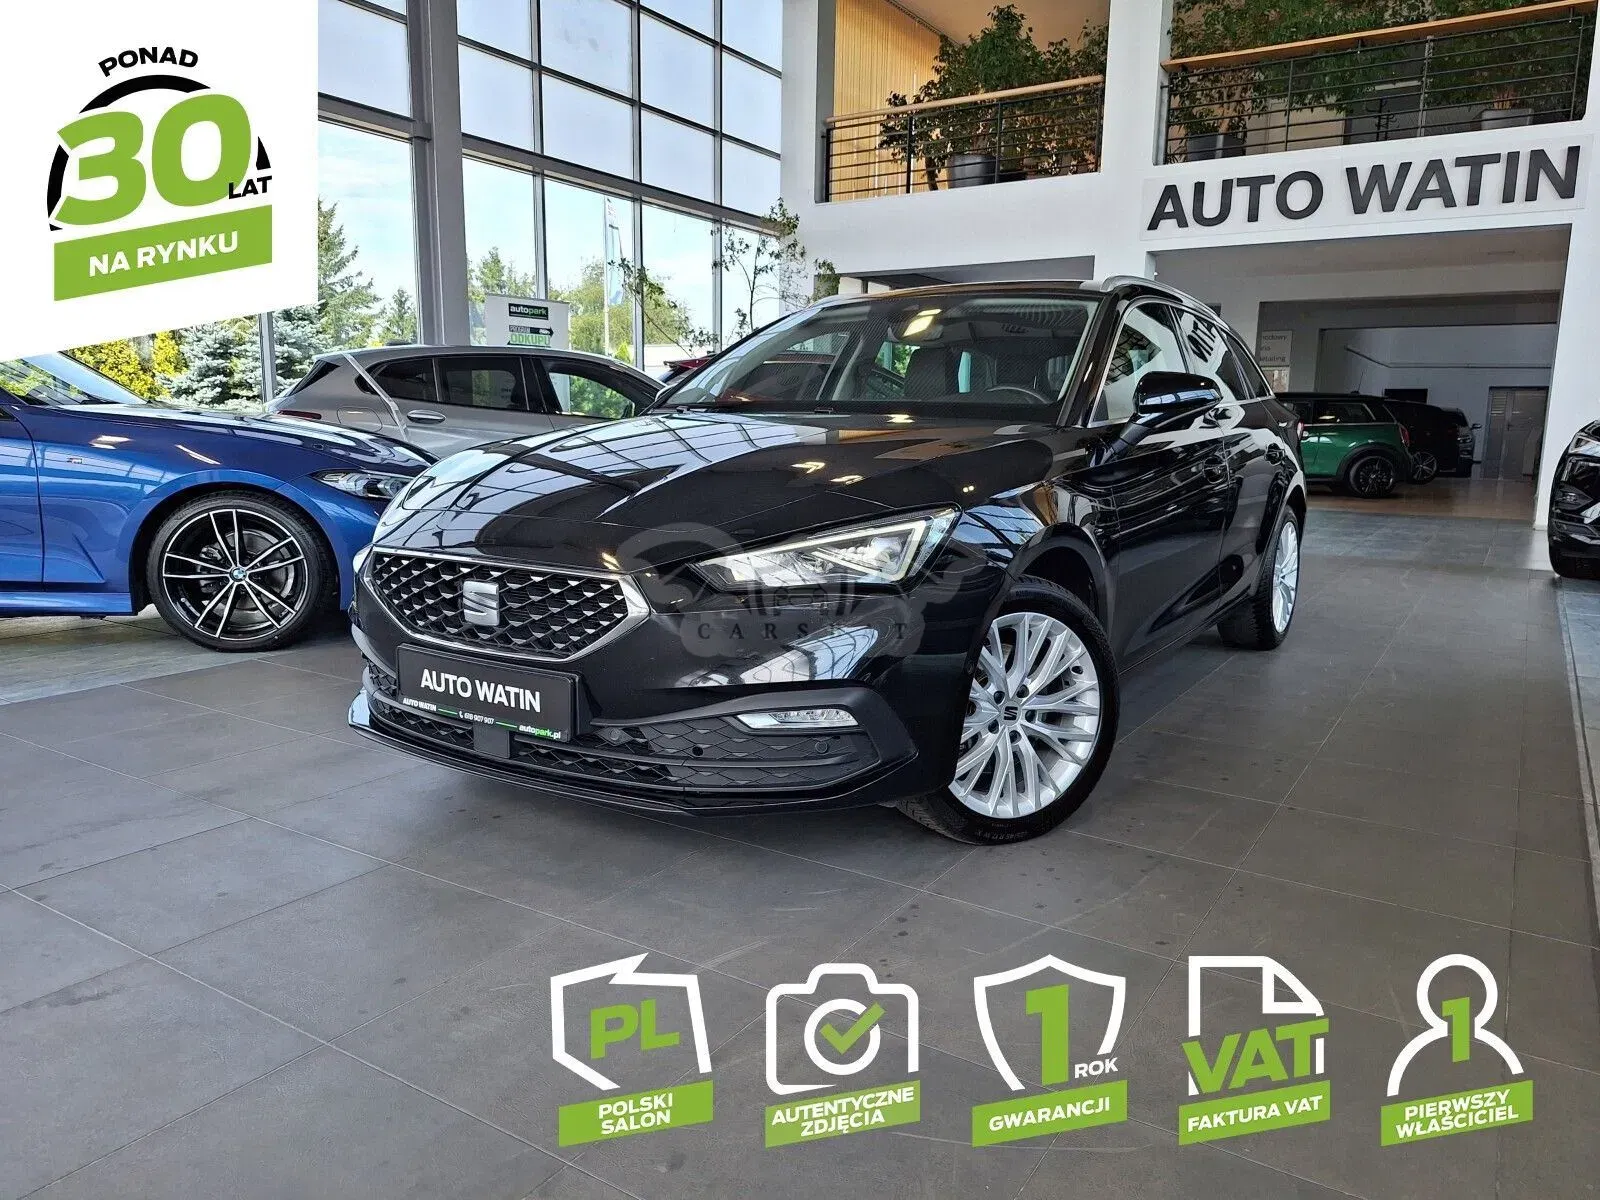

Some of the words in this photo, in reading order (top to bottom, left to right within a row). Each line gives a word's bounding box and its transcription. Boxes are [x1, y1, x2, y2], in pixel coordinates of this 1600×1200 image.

[1146, 171, 1324, 230] AUTO
[1346, 145, 1581, 214] WATIN
[510, 305, 546, 315] autopark
[421, 668, 472, 698] AUTO
[475, 679, 541, 713] WATIN
[403, 698, 418, 707] AUTO
[418, 701, 437, 712] WATIN
[519, 725, 561, 739] autopark.pl
